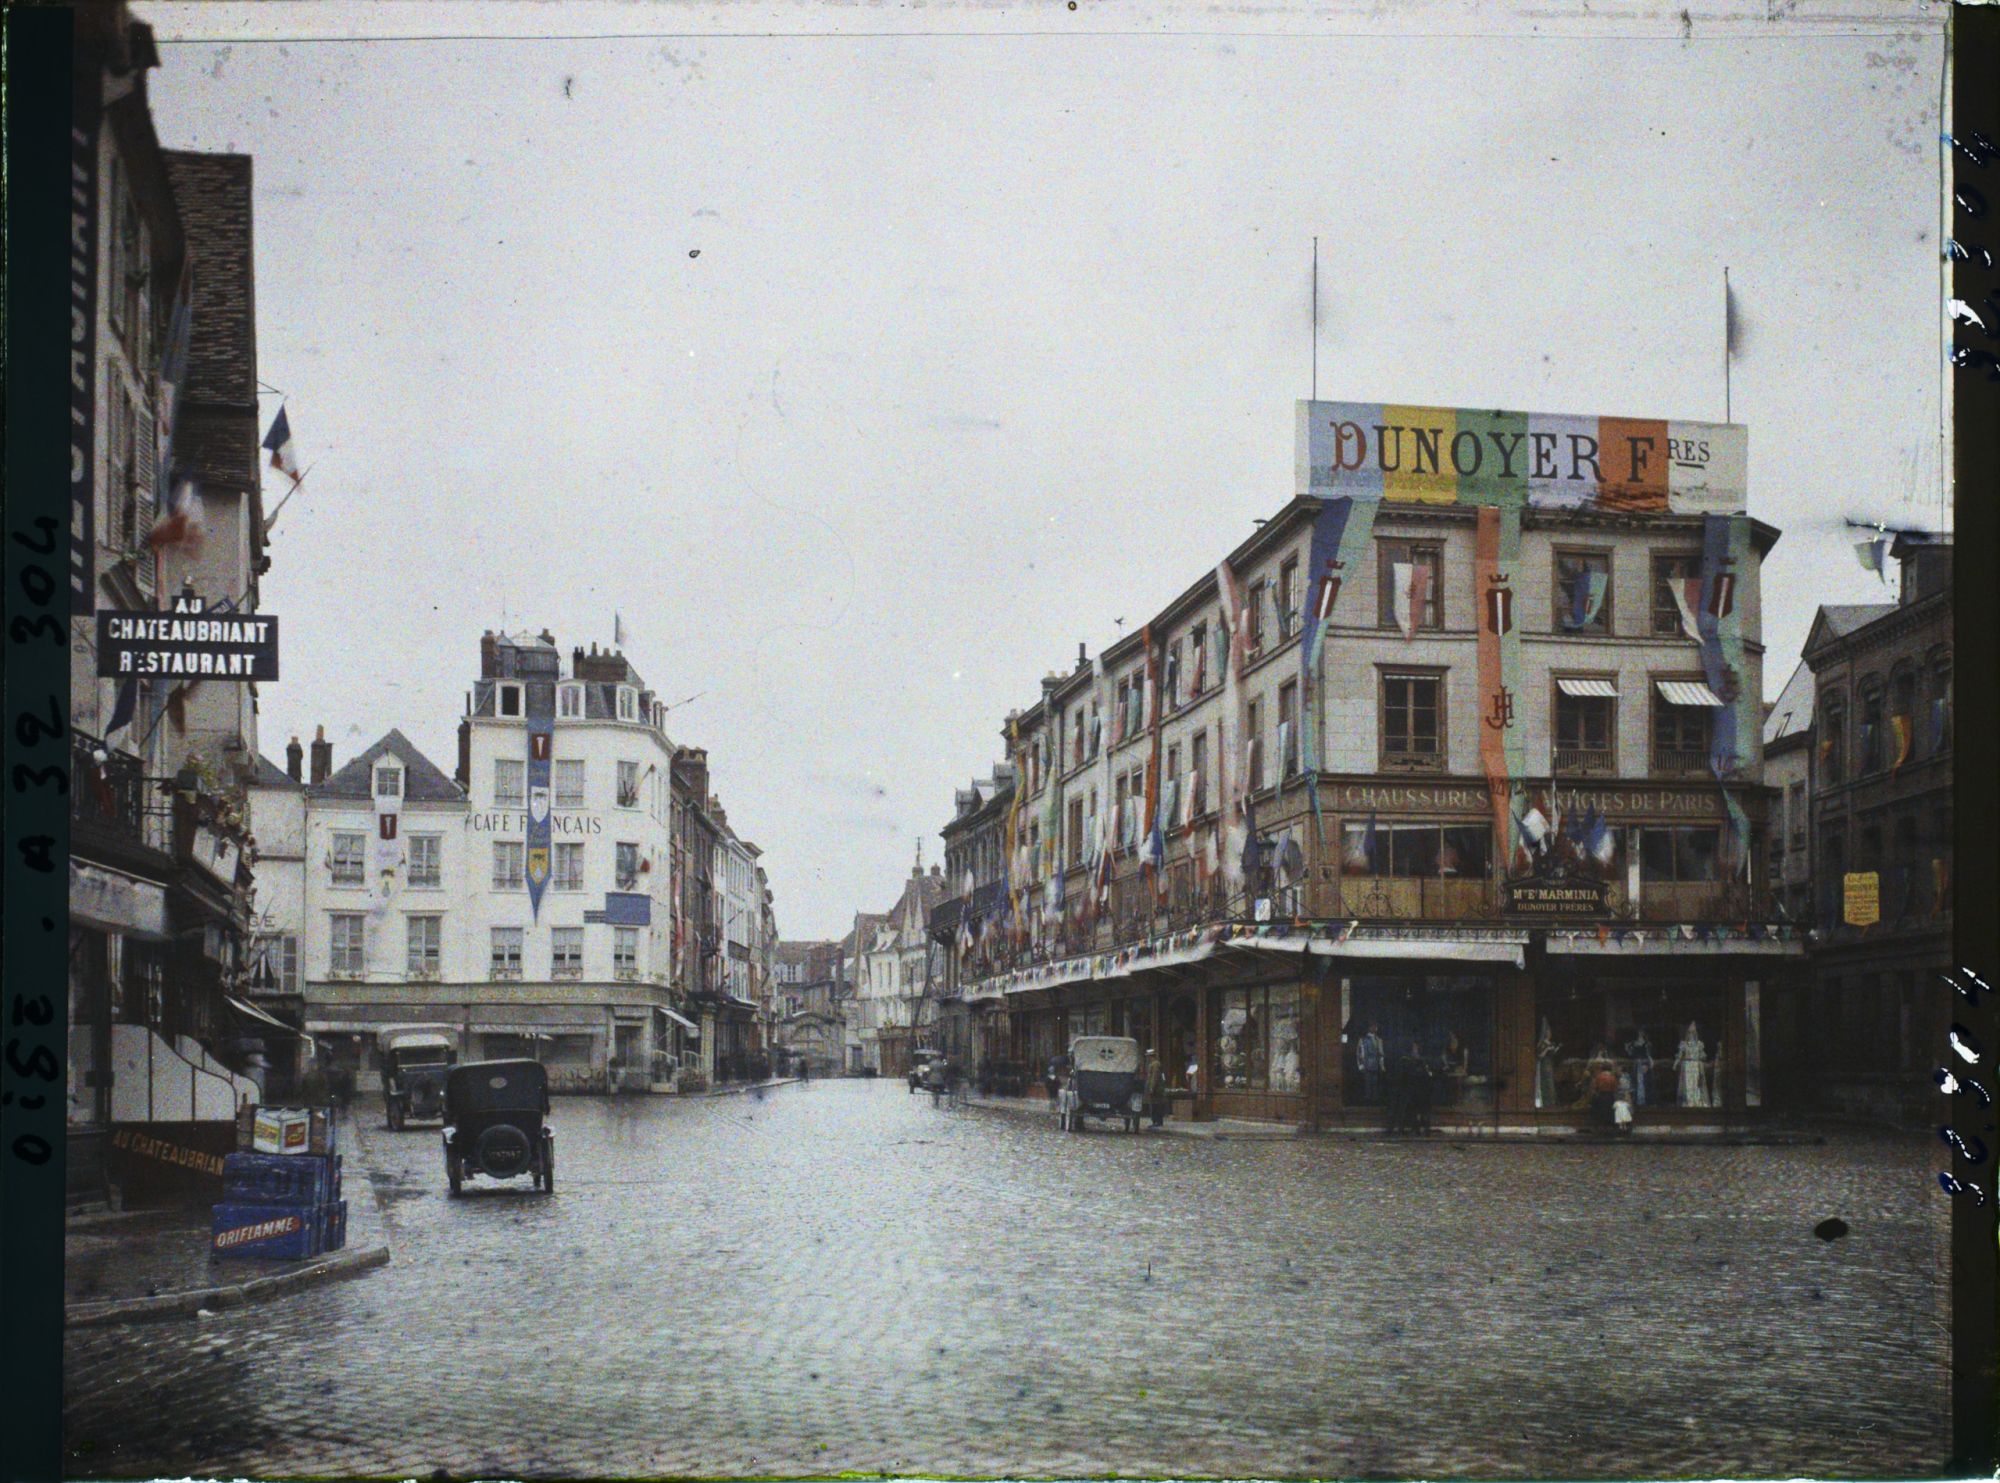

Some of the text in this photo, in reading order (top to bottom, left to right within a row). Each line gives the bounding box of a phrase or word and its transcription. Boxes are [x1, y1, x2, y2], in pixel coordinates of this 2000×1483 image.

[1330, 421, 1606, 482] DUNOYER
[175, 598, 202, 614] AU
[107, 618, 269, 643] CHATEAUBRIANT
[119, 651, 256, 675] RESTAURANT
[1346, 786, 1488, 811] CHAUSSURES
[1631, 792, 1655, 810] DE
[1659, 791, 1716, 812] PARIS
[520, 814, 602, 834] FNÇAIS
[216, 1216, 295, 1247] ORIFLAMME
